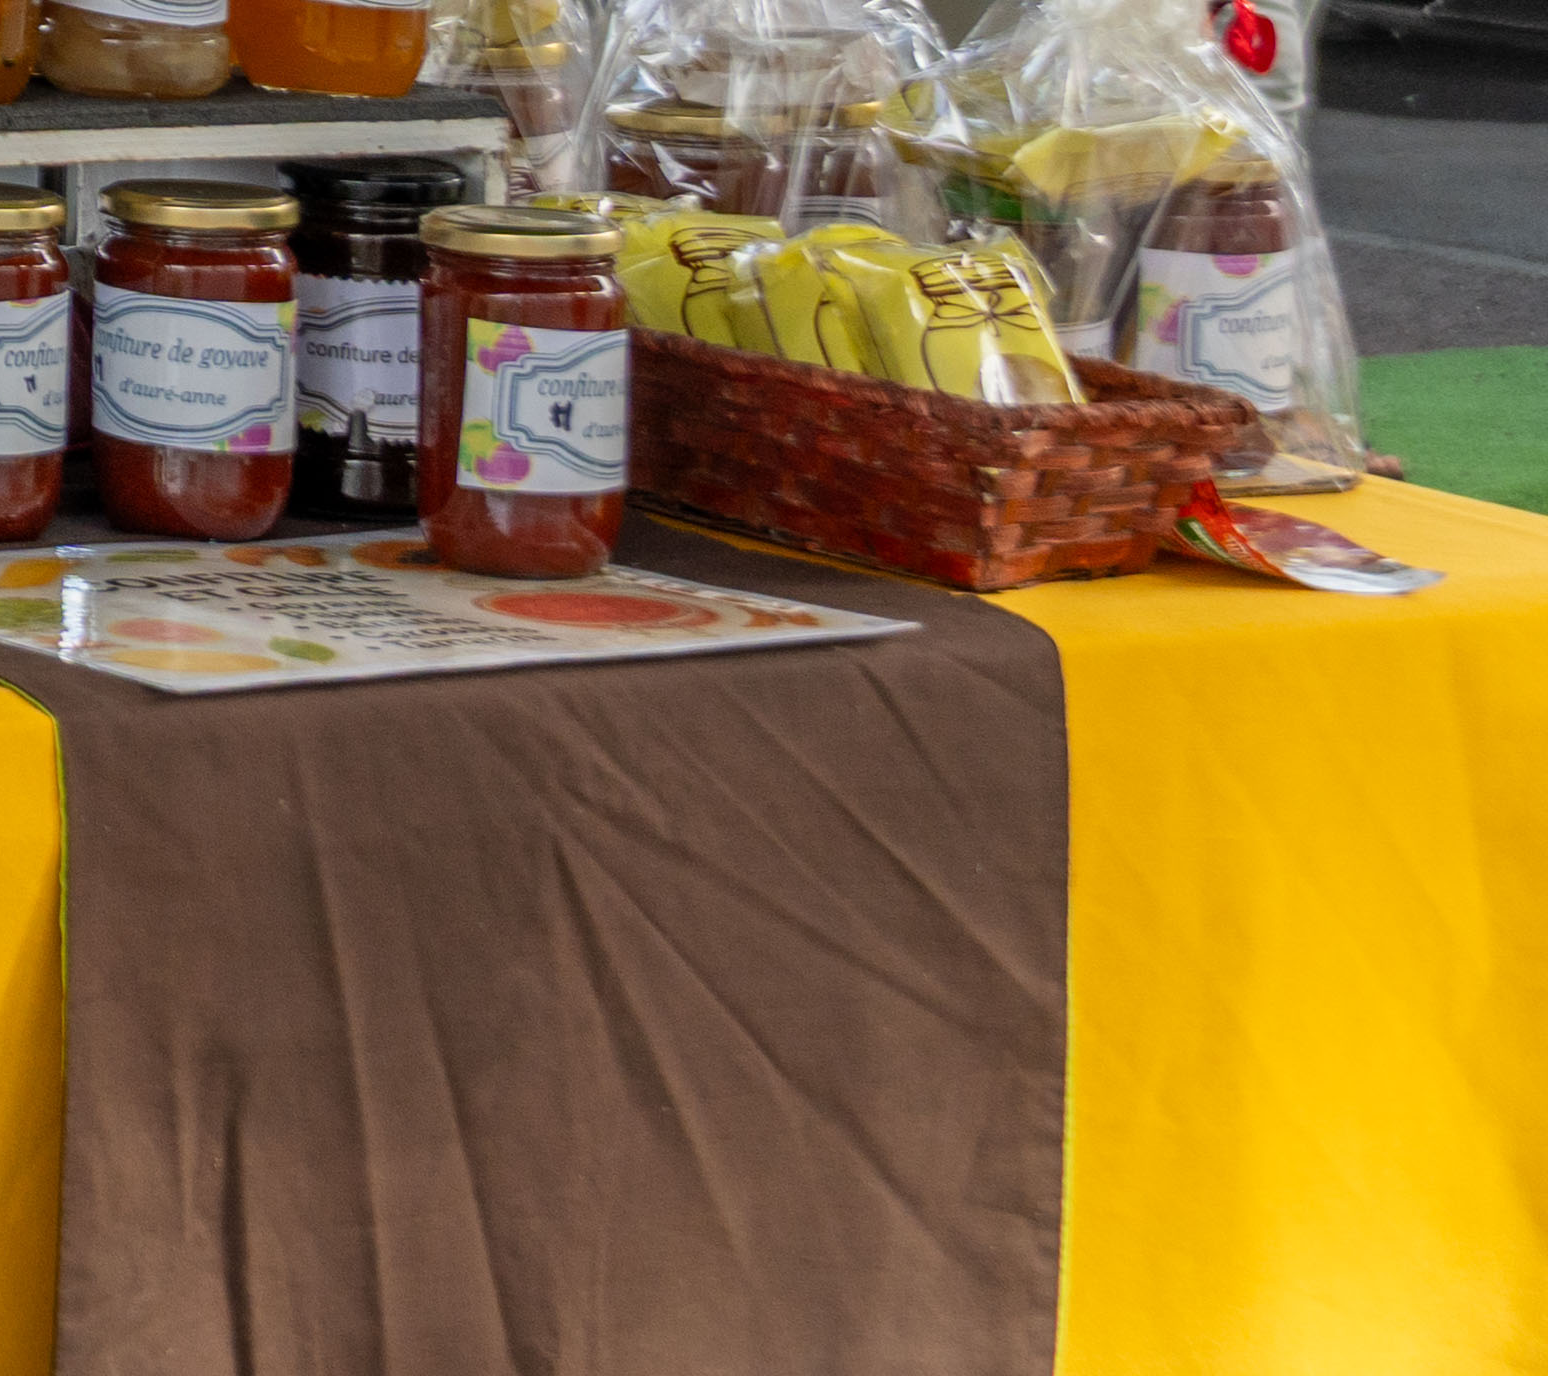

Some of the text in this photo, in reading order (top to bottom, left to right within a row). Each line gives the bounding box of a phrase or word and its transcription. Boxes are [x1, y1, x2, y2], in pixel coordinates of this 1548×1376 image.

[167, 338, 192, 363] de
[197, 348, 270, 370] goyave
[306, 341, 393, 364] confiture
[119, 377, 229, 406] d'auré-anne
[155, 587, 232, 603] ET
